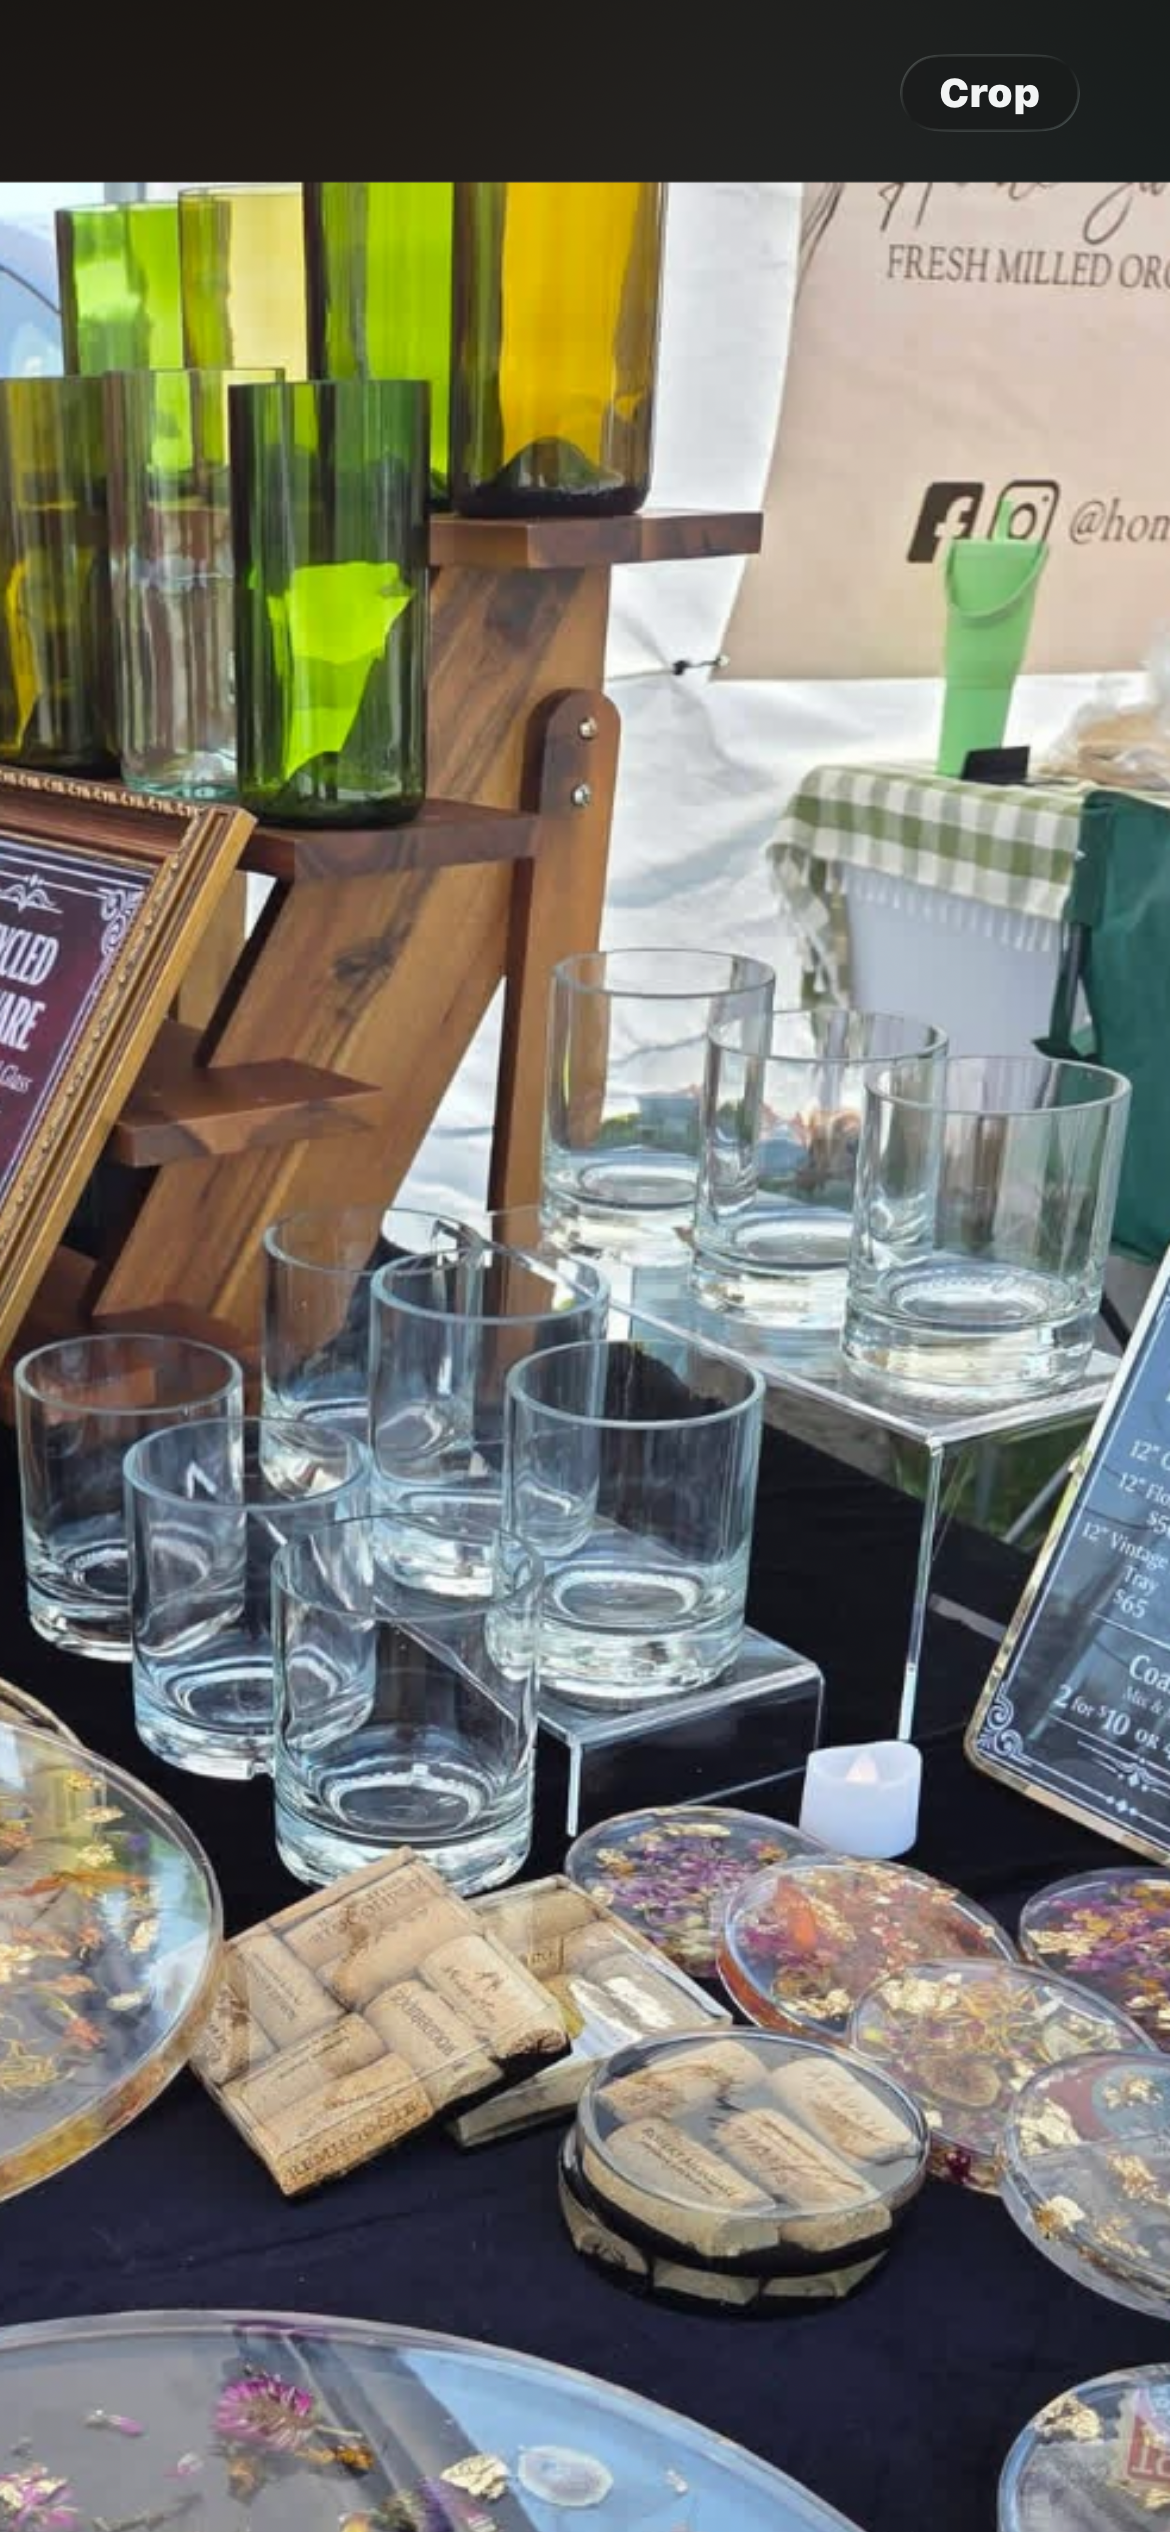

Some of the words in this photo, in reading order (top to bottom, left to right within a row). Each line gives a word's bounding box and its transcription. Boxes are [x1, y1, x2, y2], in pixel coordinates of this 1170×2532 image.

[887, 244, 990, 282] FRESH
[996, 249, 1112, 287] MILLED
[0, 990, 47, 1051] ARE
[1109, 1531, 1169, 1571] Vintage
[1123, 1565, 1160, 1597] Tray
[1113, 1587, 1149, 1619] $65
[1053, 1684, 1073, 1709] 2
[1070, 1695, 1096, 1718] for
[1097, 1704, 1132, 1736] $10
